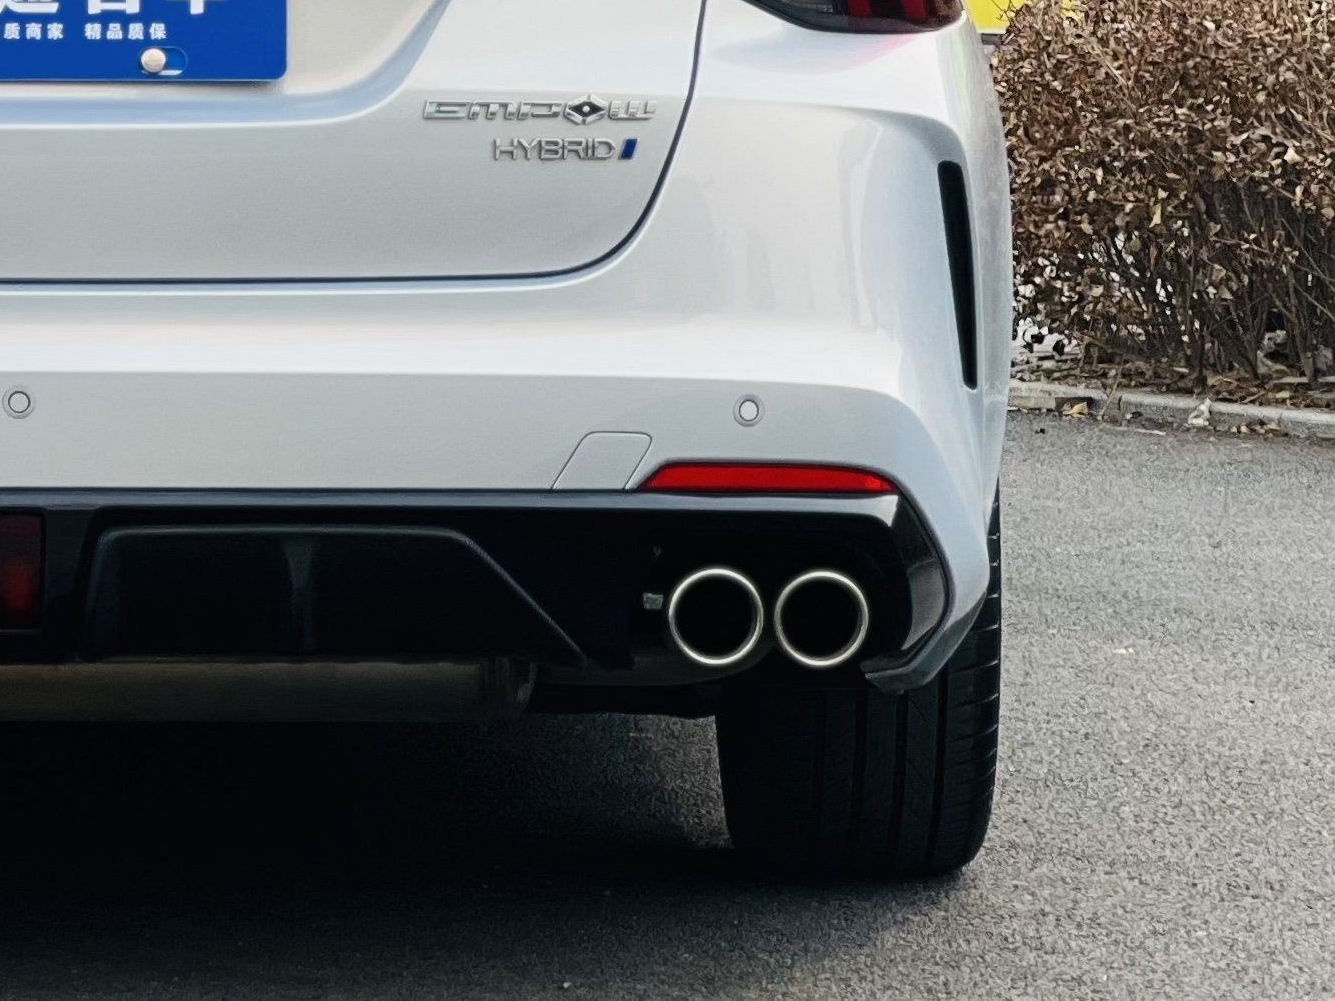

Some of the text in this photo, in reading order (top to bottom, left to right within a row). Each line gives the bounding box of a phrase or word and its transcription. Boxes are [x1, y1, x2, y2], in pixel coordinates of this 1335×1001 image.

[84, 22, 167, 40] 精品质保
[494, 137, 617, 161] HYBRID
